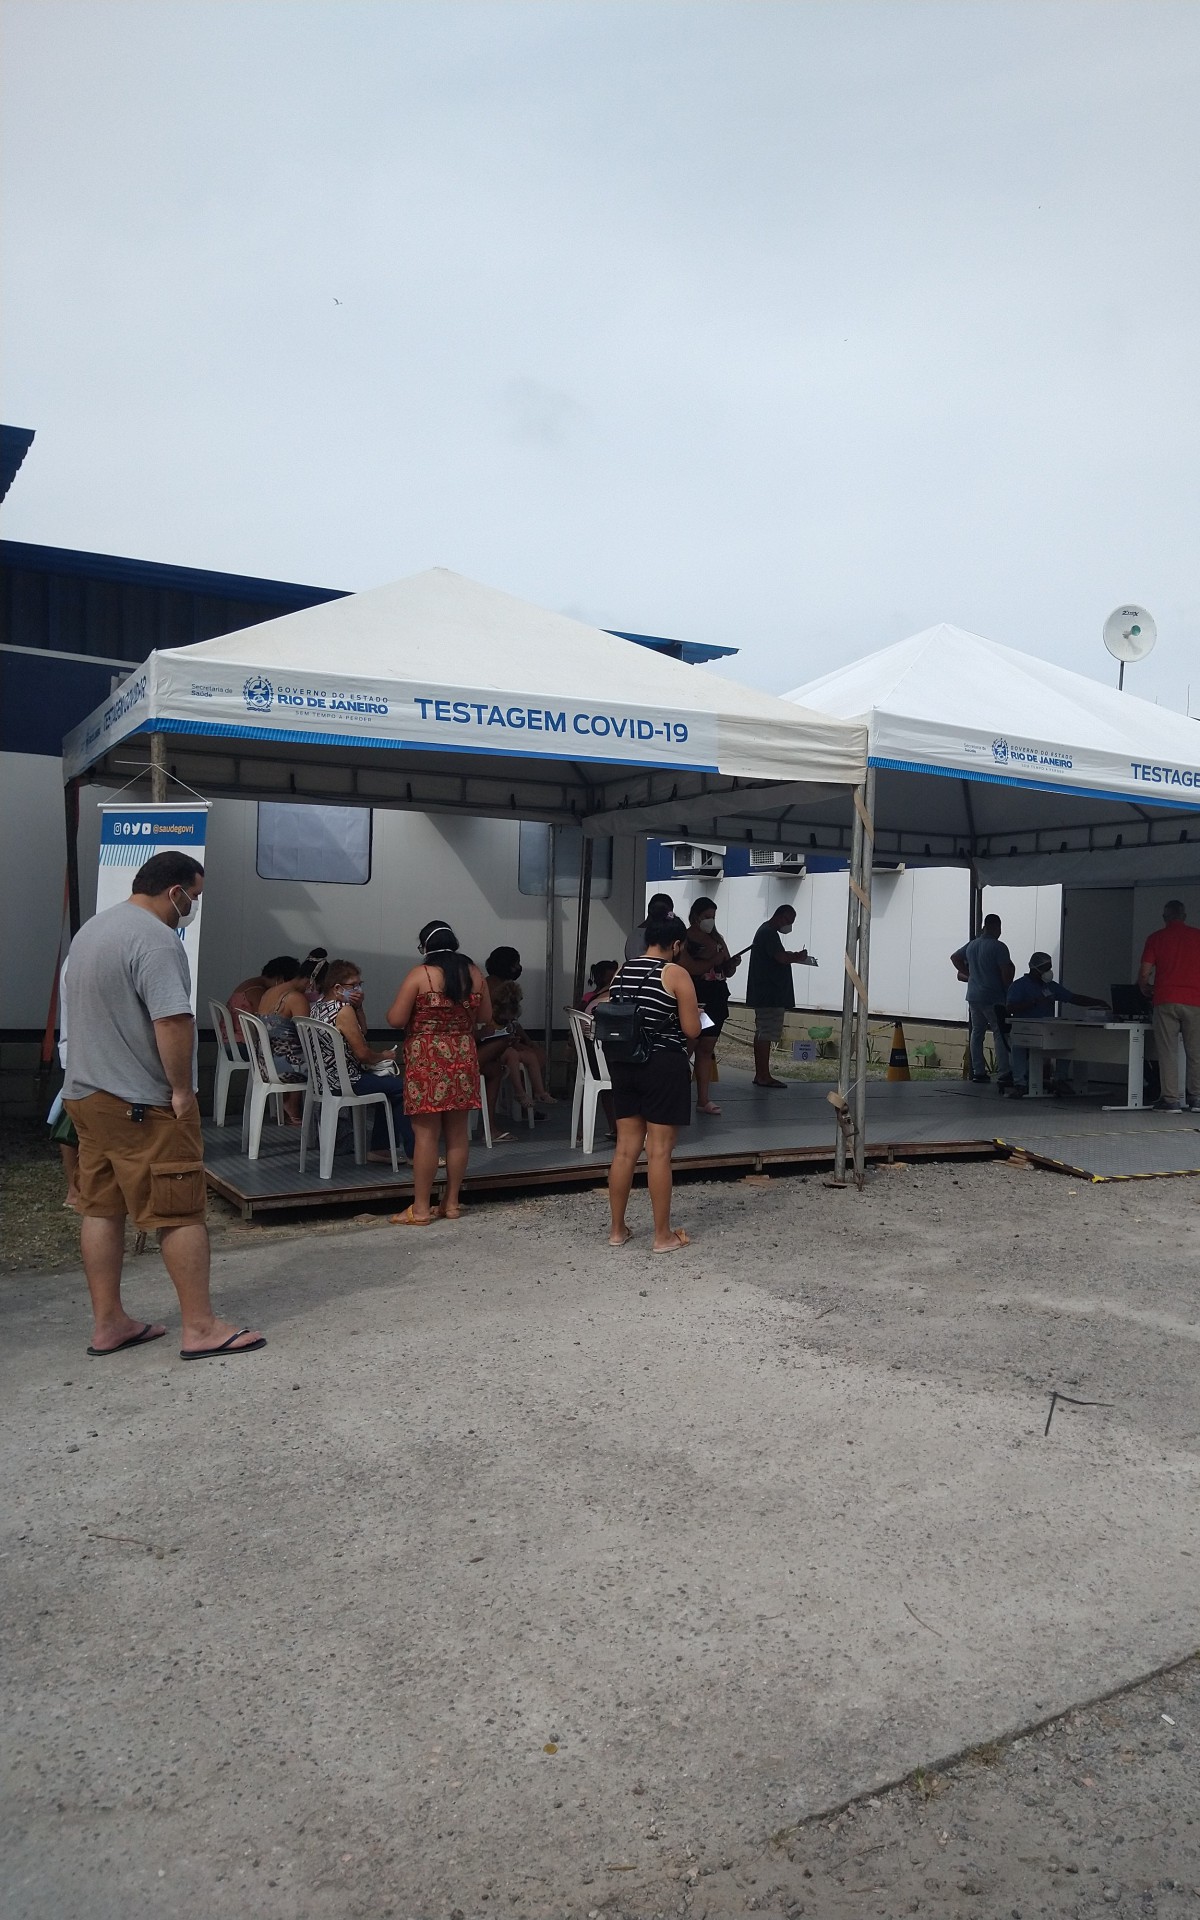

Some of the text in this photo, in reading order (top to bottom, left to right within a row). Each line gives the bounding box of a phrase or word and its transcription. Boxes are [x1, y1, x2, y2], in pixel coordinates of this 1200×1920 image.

[191, 684, 223, 693] Secretaria
[191, 690, 213, 698] Saúde
[277, 686, 327, 697] GOVERNO
[350, 694, 389, 703] ESTADO
[277, 694, 389, 715] RIO DE JANEIRO
[312, 711, 336, 719] TEMPO
[414, 697, 689, 743] TESTAGEM COVID-19
[1010, 751, 1026, 761] RIO
[1027, 754, 1038, 763] DE
[1039, 756, 1073, 769] JANEIRO
[153, 824, 194, 834] @saudegovrj
